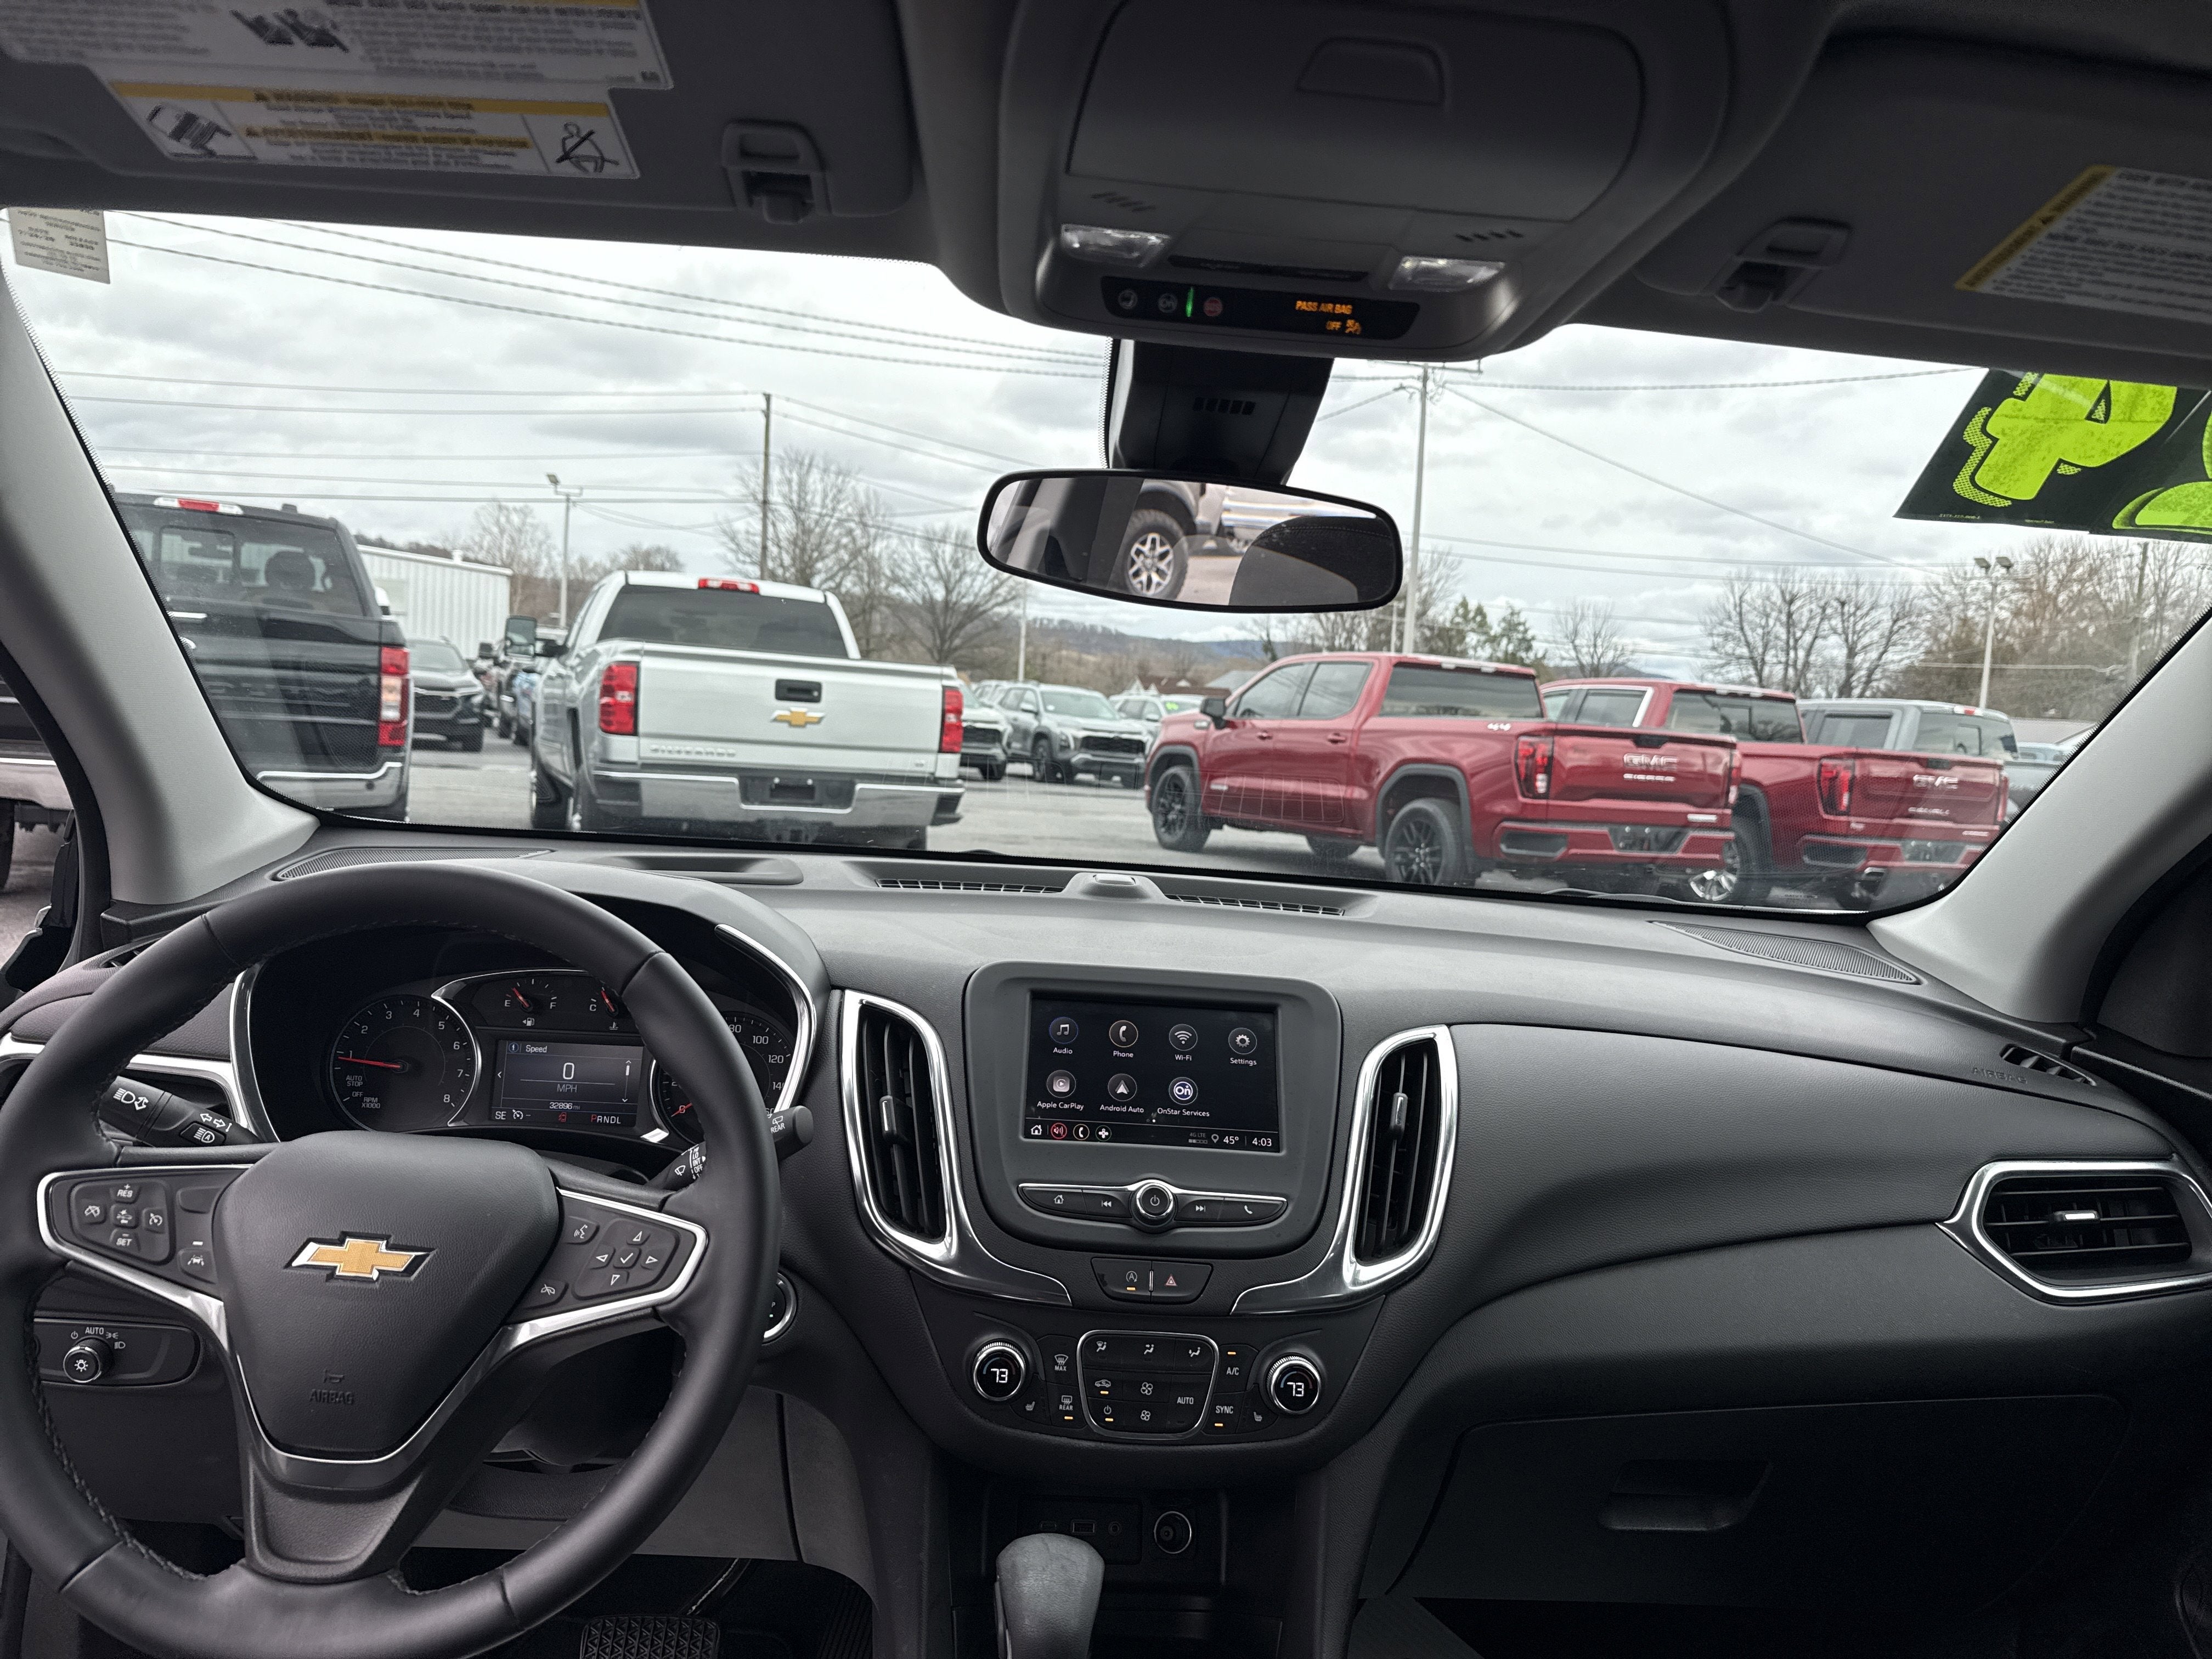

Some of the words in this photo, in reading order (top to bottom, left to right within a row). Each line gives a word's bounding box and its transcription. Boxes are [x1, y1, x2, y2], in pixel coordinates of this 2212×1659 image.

[1295, 300, 1318, 312] PASS
[1319, 302, 1334, 313] AIR
[1334, 304, 1352, 315] BAG
[1325, 320, 1342, 331] OFF
[505, 999, 511, 1007] E
[589, 1003, 597, 1012] C
[386, 1011, 392, 1020] 3
[413, 1009, 420, 1018] 4
[361, 1025, 368, 1034] 2
[438, 1021, 445, 1030] 5
[753, 1035, 769, 1044] 100
[453, 1041, 460, 1050] 6
[525, 1045, 548, 1054] Speed
[348, 1050, 353, 1059] 1
[768, 1054, 784, 1063] 120
[1230, 1058, 1257, 1066] Settings
[457, 1069, 464, 1078] 7
[563, 1062, 574, 1080] 0
[1973, 1066, 2029, 1085] AIRBAG
[557, 1083, 578, 1093] MPH
[772, 1081, 784, 1090] 14
[1175, 1085, 1191, 1096] On
[443, 1094, 450, 1103] 8
[549, 1102, 573, 1110] 32896
[1037, 1101, 1057, 1109] Apple
[1059, 1102, 1084, 1111] CarPlay
[495, 1111, 506, 1120] SE
[770, 1123, 786, 1133] REAR
[1252, 1137, 1272, 1147] 4:03
[692, 1152, 699, 1160] LO
[692, 1157, 701, 1167] INT
[693, 1164, 703, 1173] OFF
[117, 1189, 133, 1198] RES
[116, 1238, 133, 1246] SET
[85, 1327, 104, 1336] AUTO
[990, 1368, 1008, 1383] 73
[1226, 1367, 1239, 1376] A/C
[1286, 1382, 1305, 1397] 73
[309, 1389, 355, 1406] AIRBAG
[1215, 1406, 1234, 1414] SYNC
